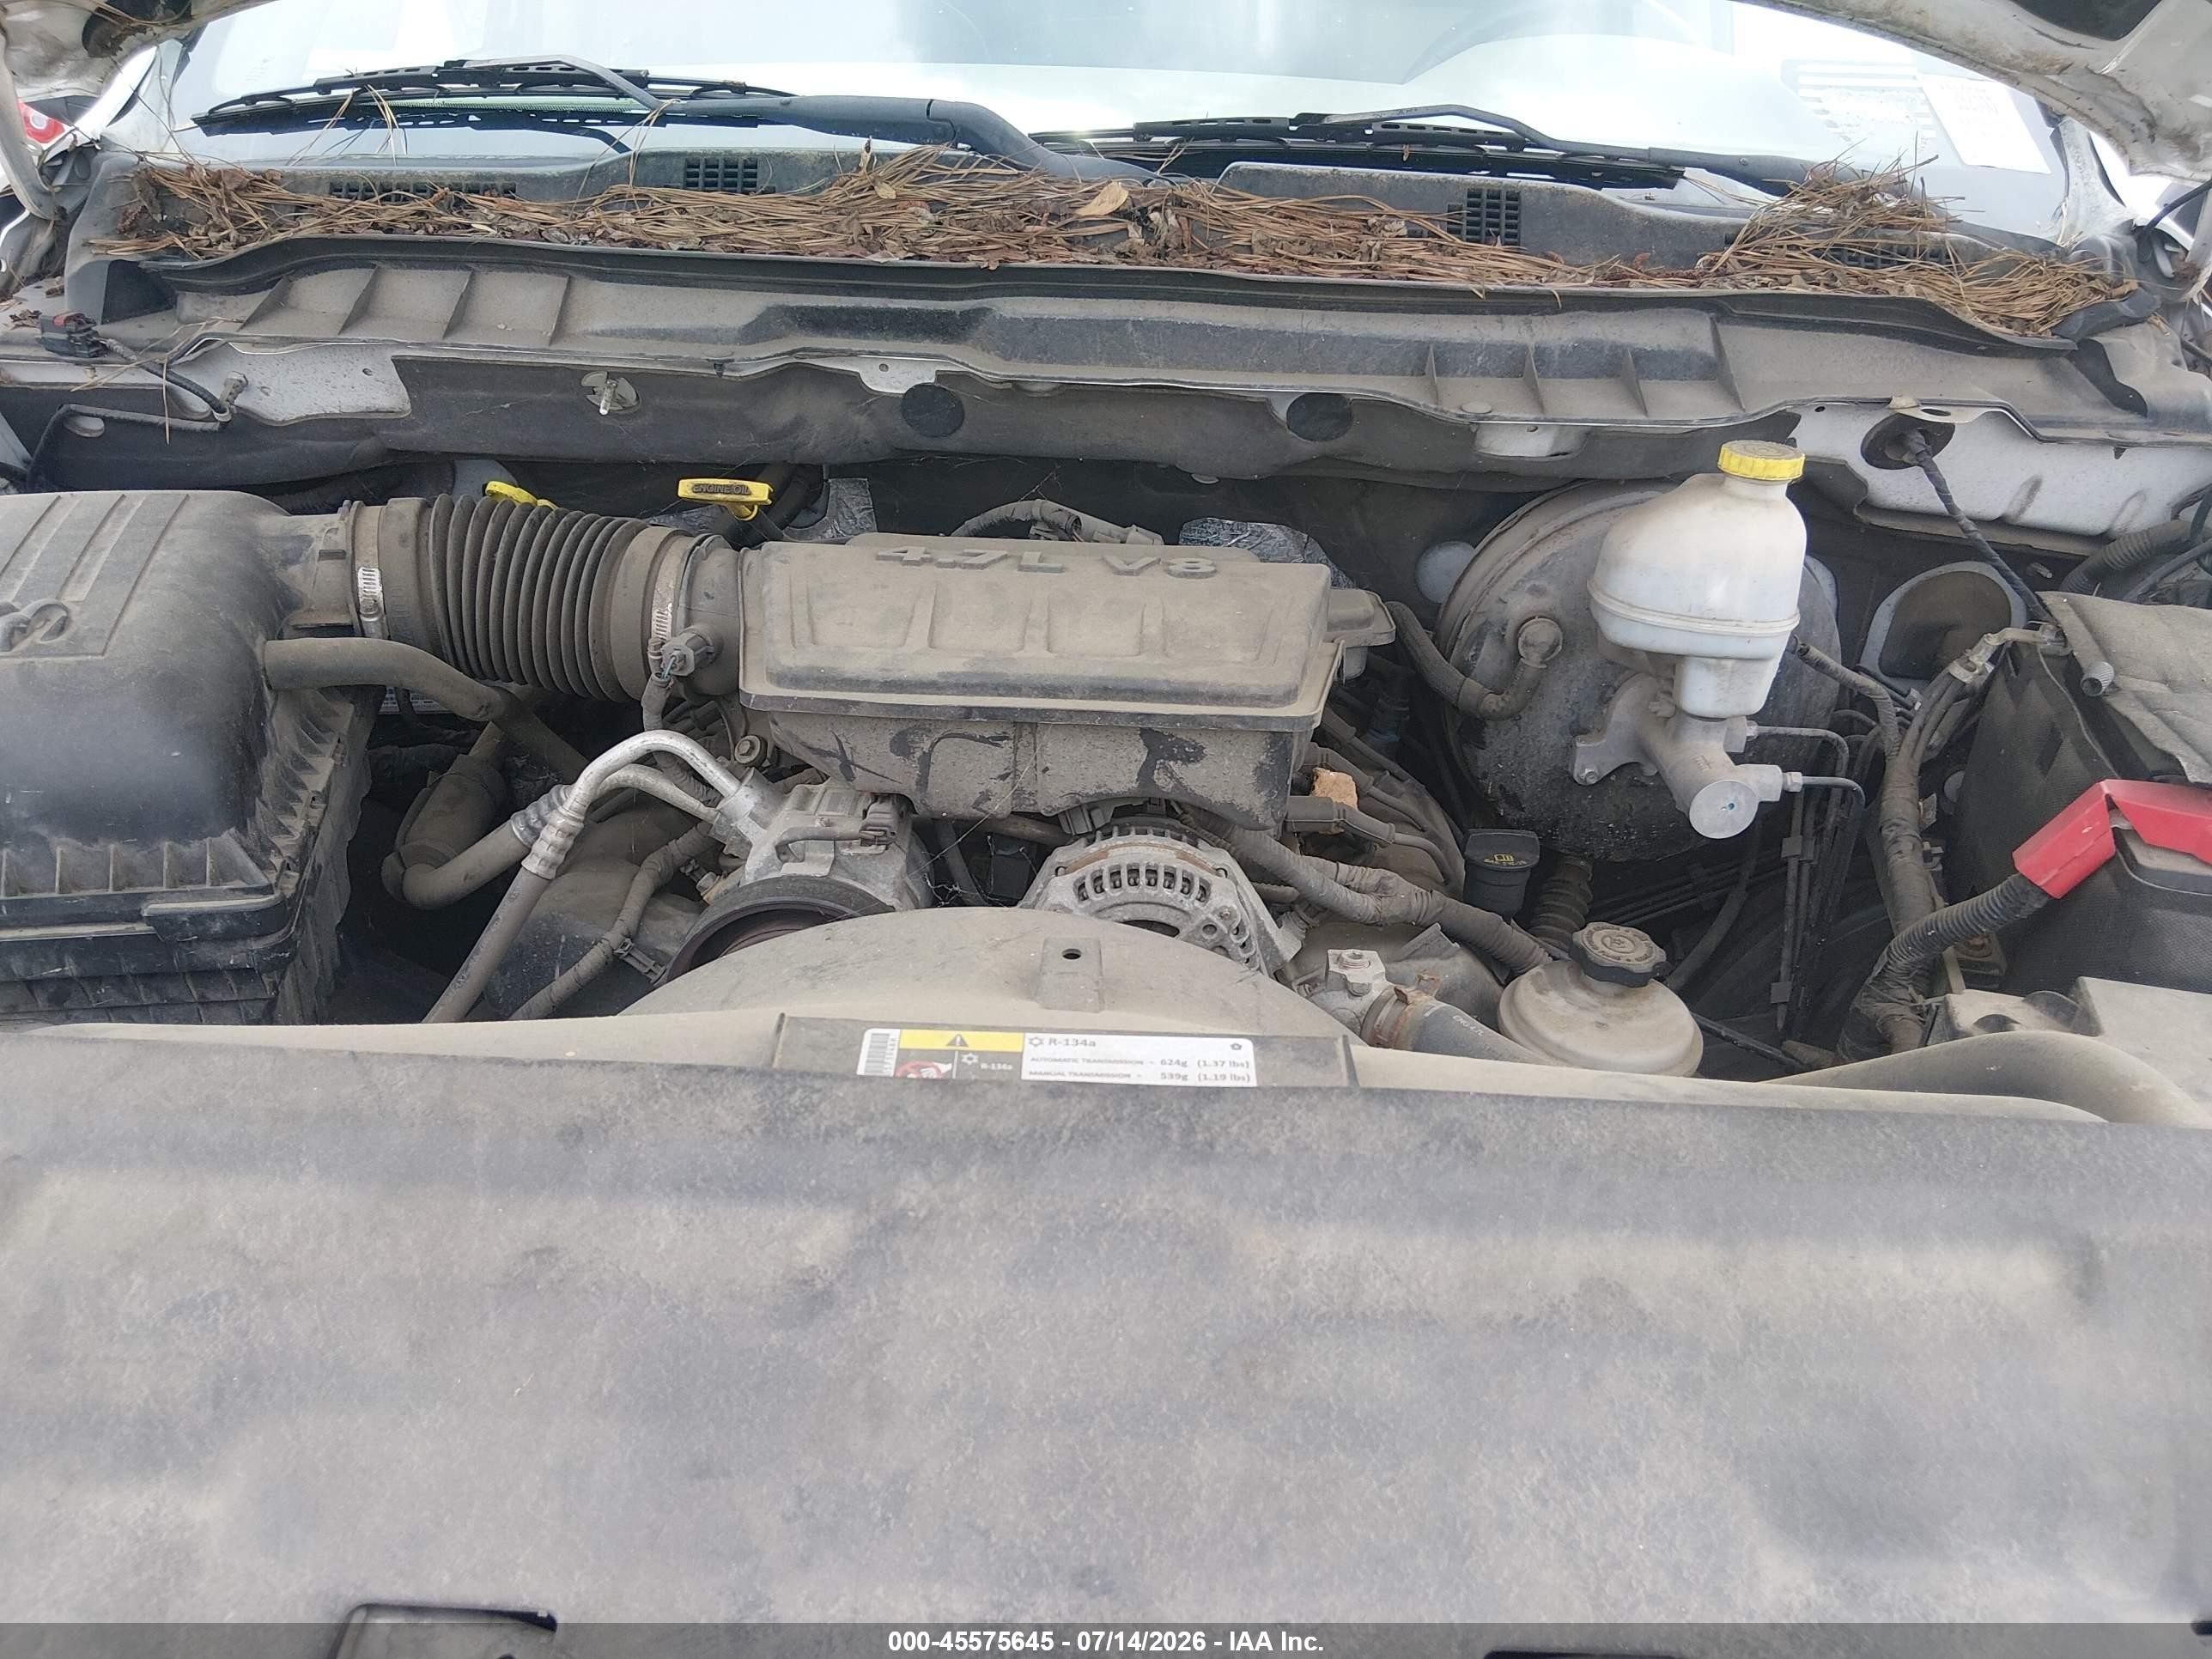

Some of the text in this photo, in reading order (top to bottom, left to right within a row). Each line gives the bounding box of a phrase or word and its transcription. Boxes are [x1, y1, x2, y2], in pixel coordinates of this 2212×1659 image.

[692, 483, 752, 495] ENGINE OIL
[876, 546, 1217, 579] 4.7L V8
[1048, 1037, 1097, 1048] R-134a
[1160, 1059, 1188, 1068] 624g
[1197, 1059, 1226, 1069] (1.37
[1229, 1060, 1250, 1070] lbs)
[1160, 1072, 1188, 1082] 539g
